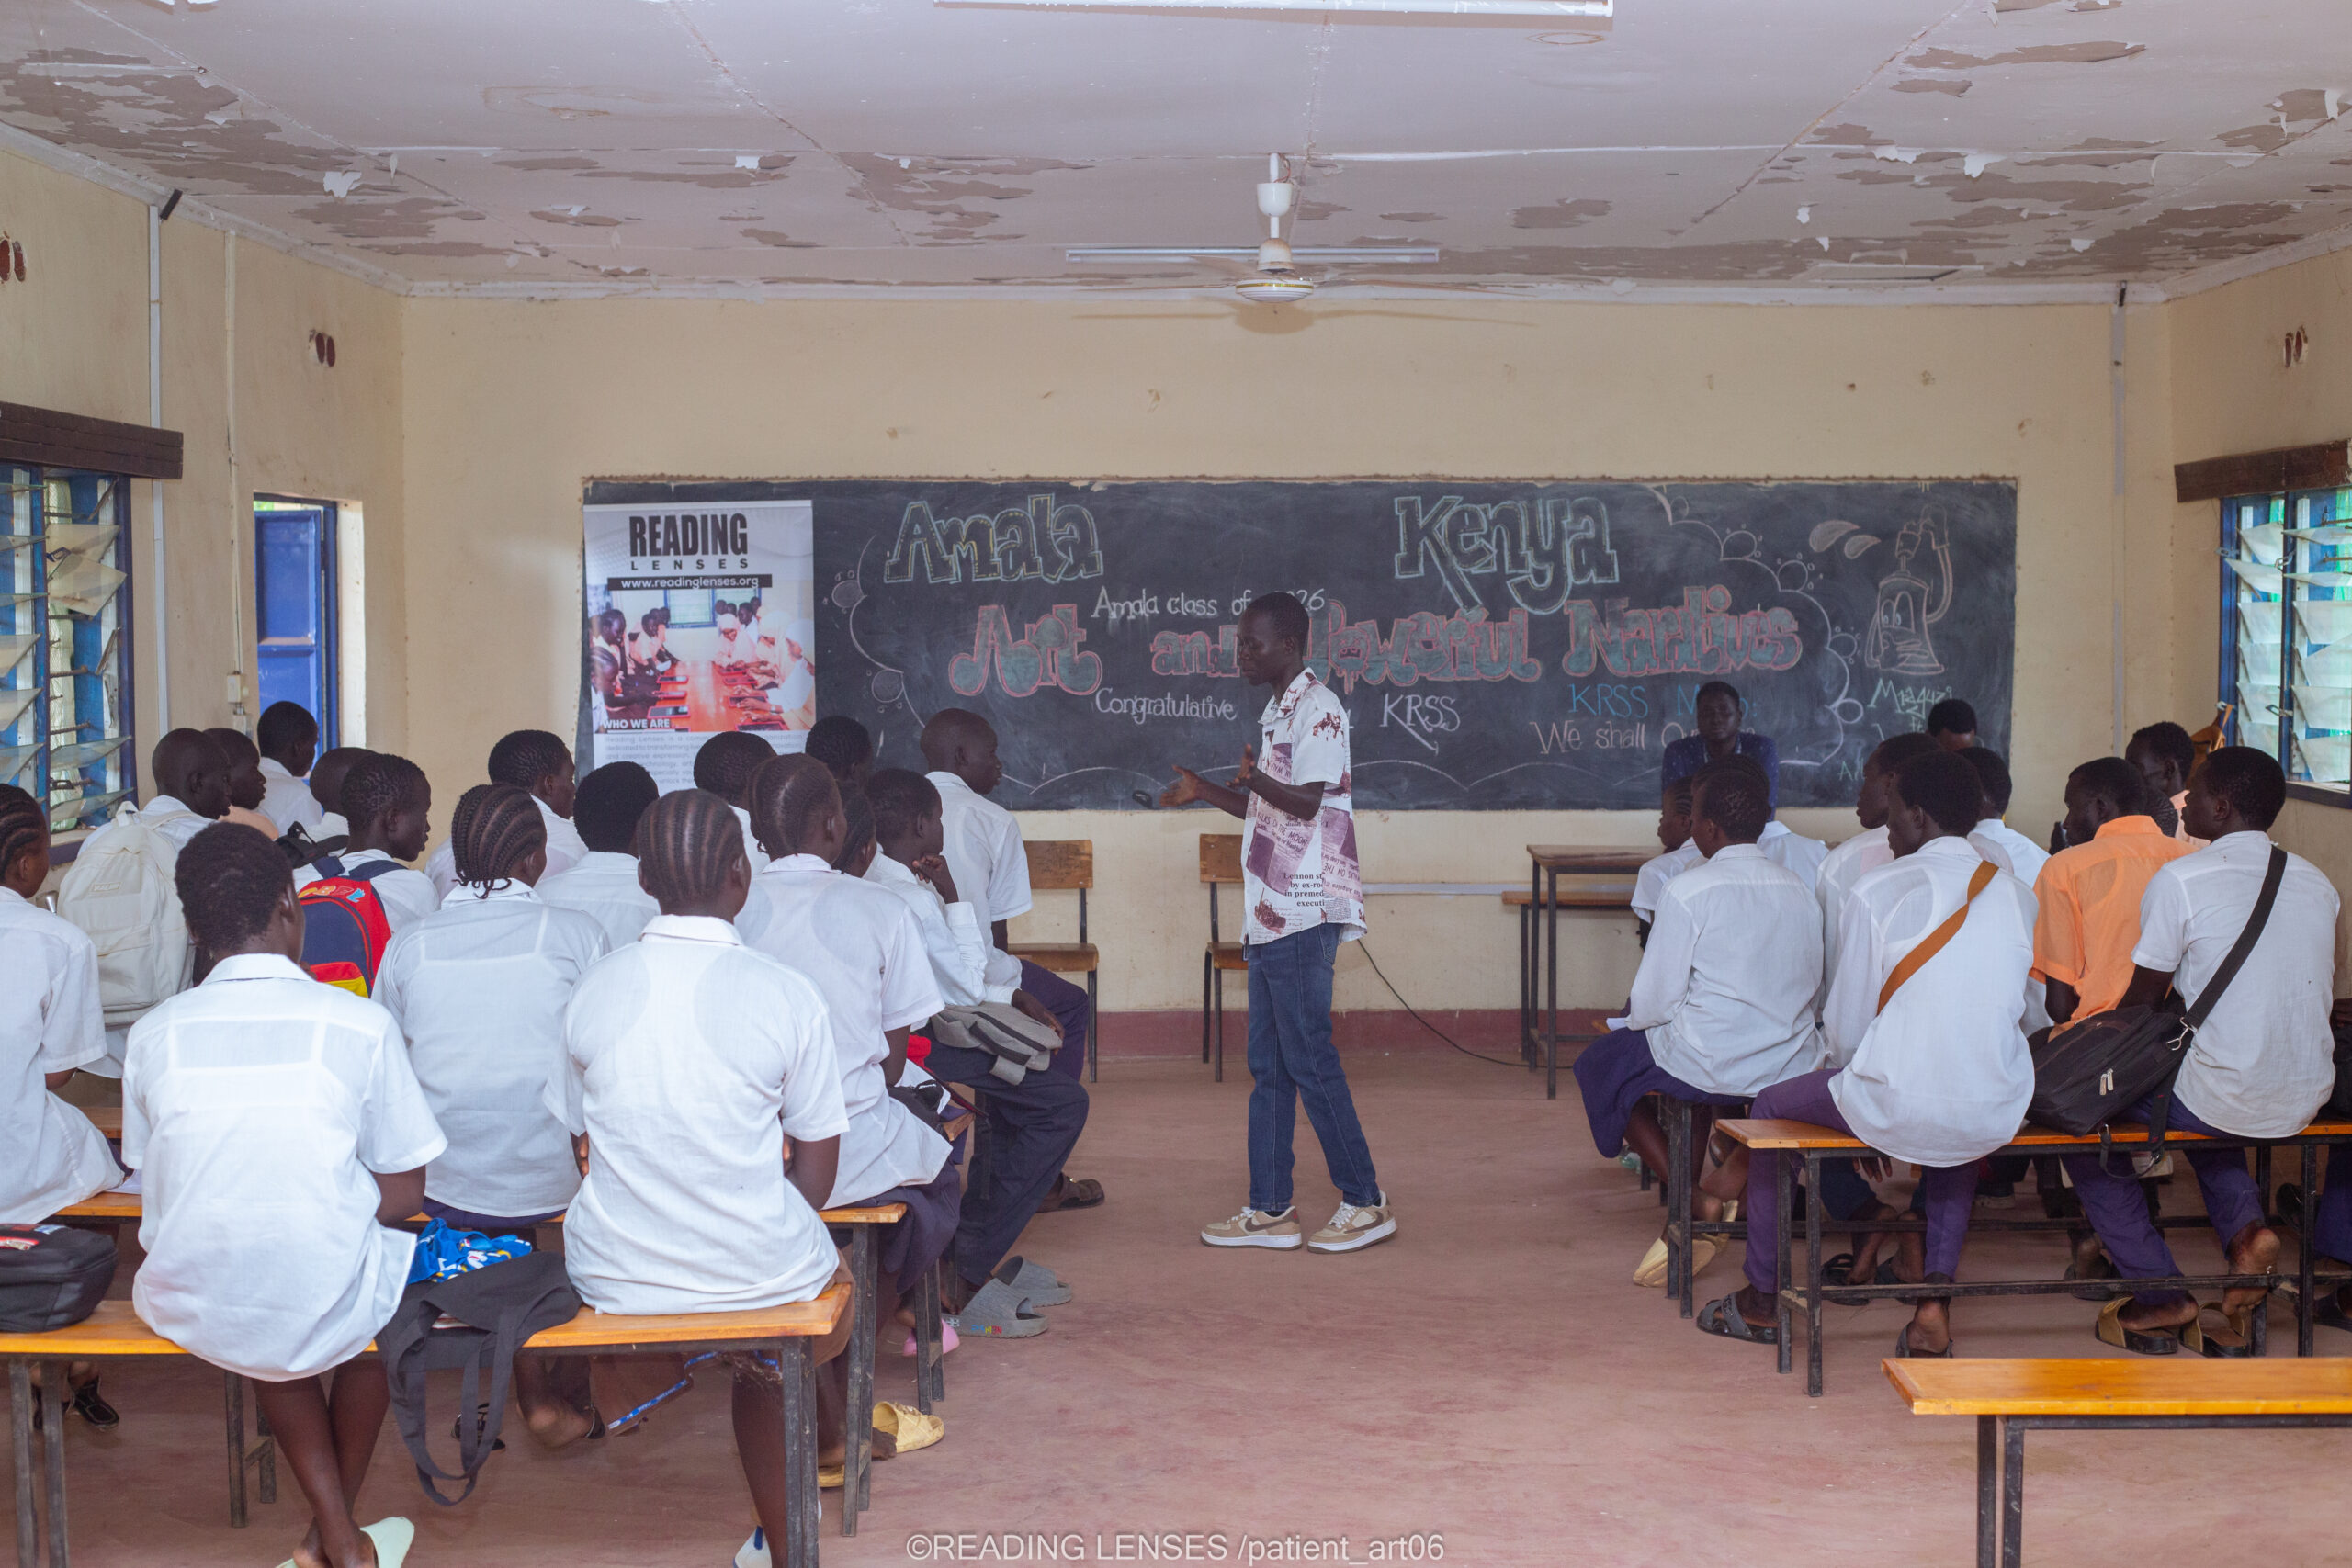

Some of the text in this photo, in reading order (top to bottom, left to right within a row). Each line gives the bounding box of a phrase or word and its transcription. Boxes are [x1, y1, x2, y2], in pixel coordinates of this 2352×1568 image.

[629, 513, 749, 557] READING
[884, 493, 1102, 584] Amala
[630, 558, 749, 570] LENSES
[1395, 495, 1619, 615] Kenya
[621, 576, 759, 589] www.readinglenses.org
[1091, 586, 1159, 620] Amala
[1167, 592, 1217, 617] class
[1231, 590, 1252, 616] of
[948, 604, 1102, 697] Art
[1150, 625, 1240, 678] and
[1095, 687, 1238, 724] Congratulative
[1567, 683, 1649, 719] KRSS
[603, 718, 670, 728] WHO WE ARE
[1380, 693, 1461, 756] KRSS
[1530, 720, 1581, 754] We
[1595, 720, 1645, 750] shall
[1290, 881, 1299, 889] by
